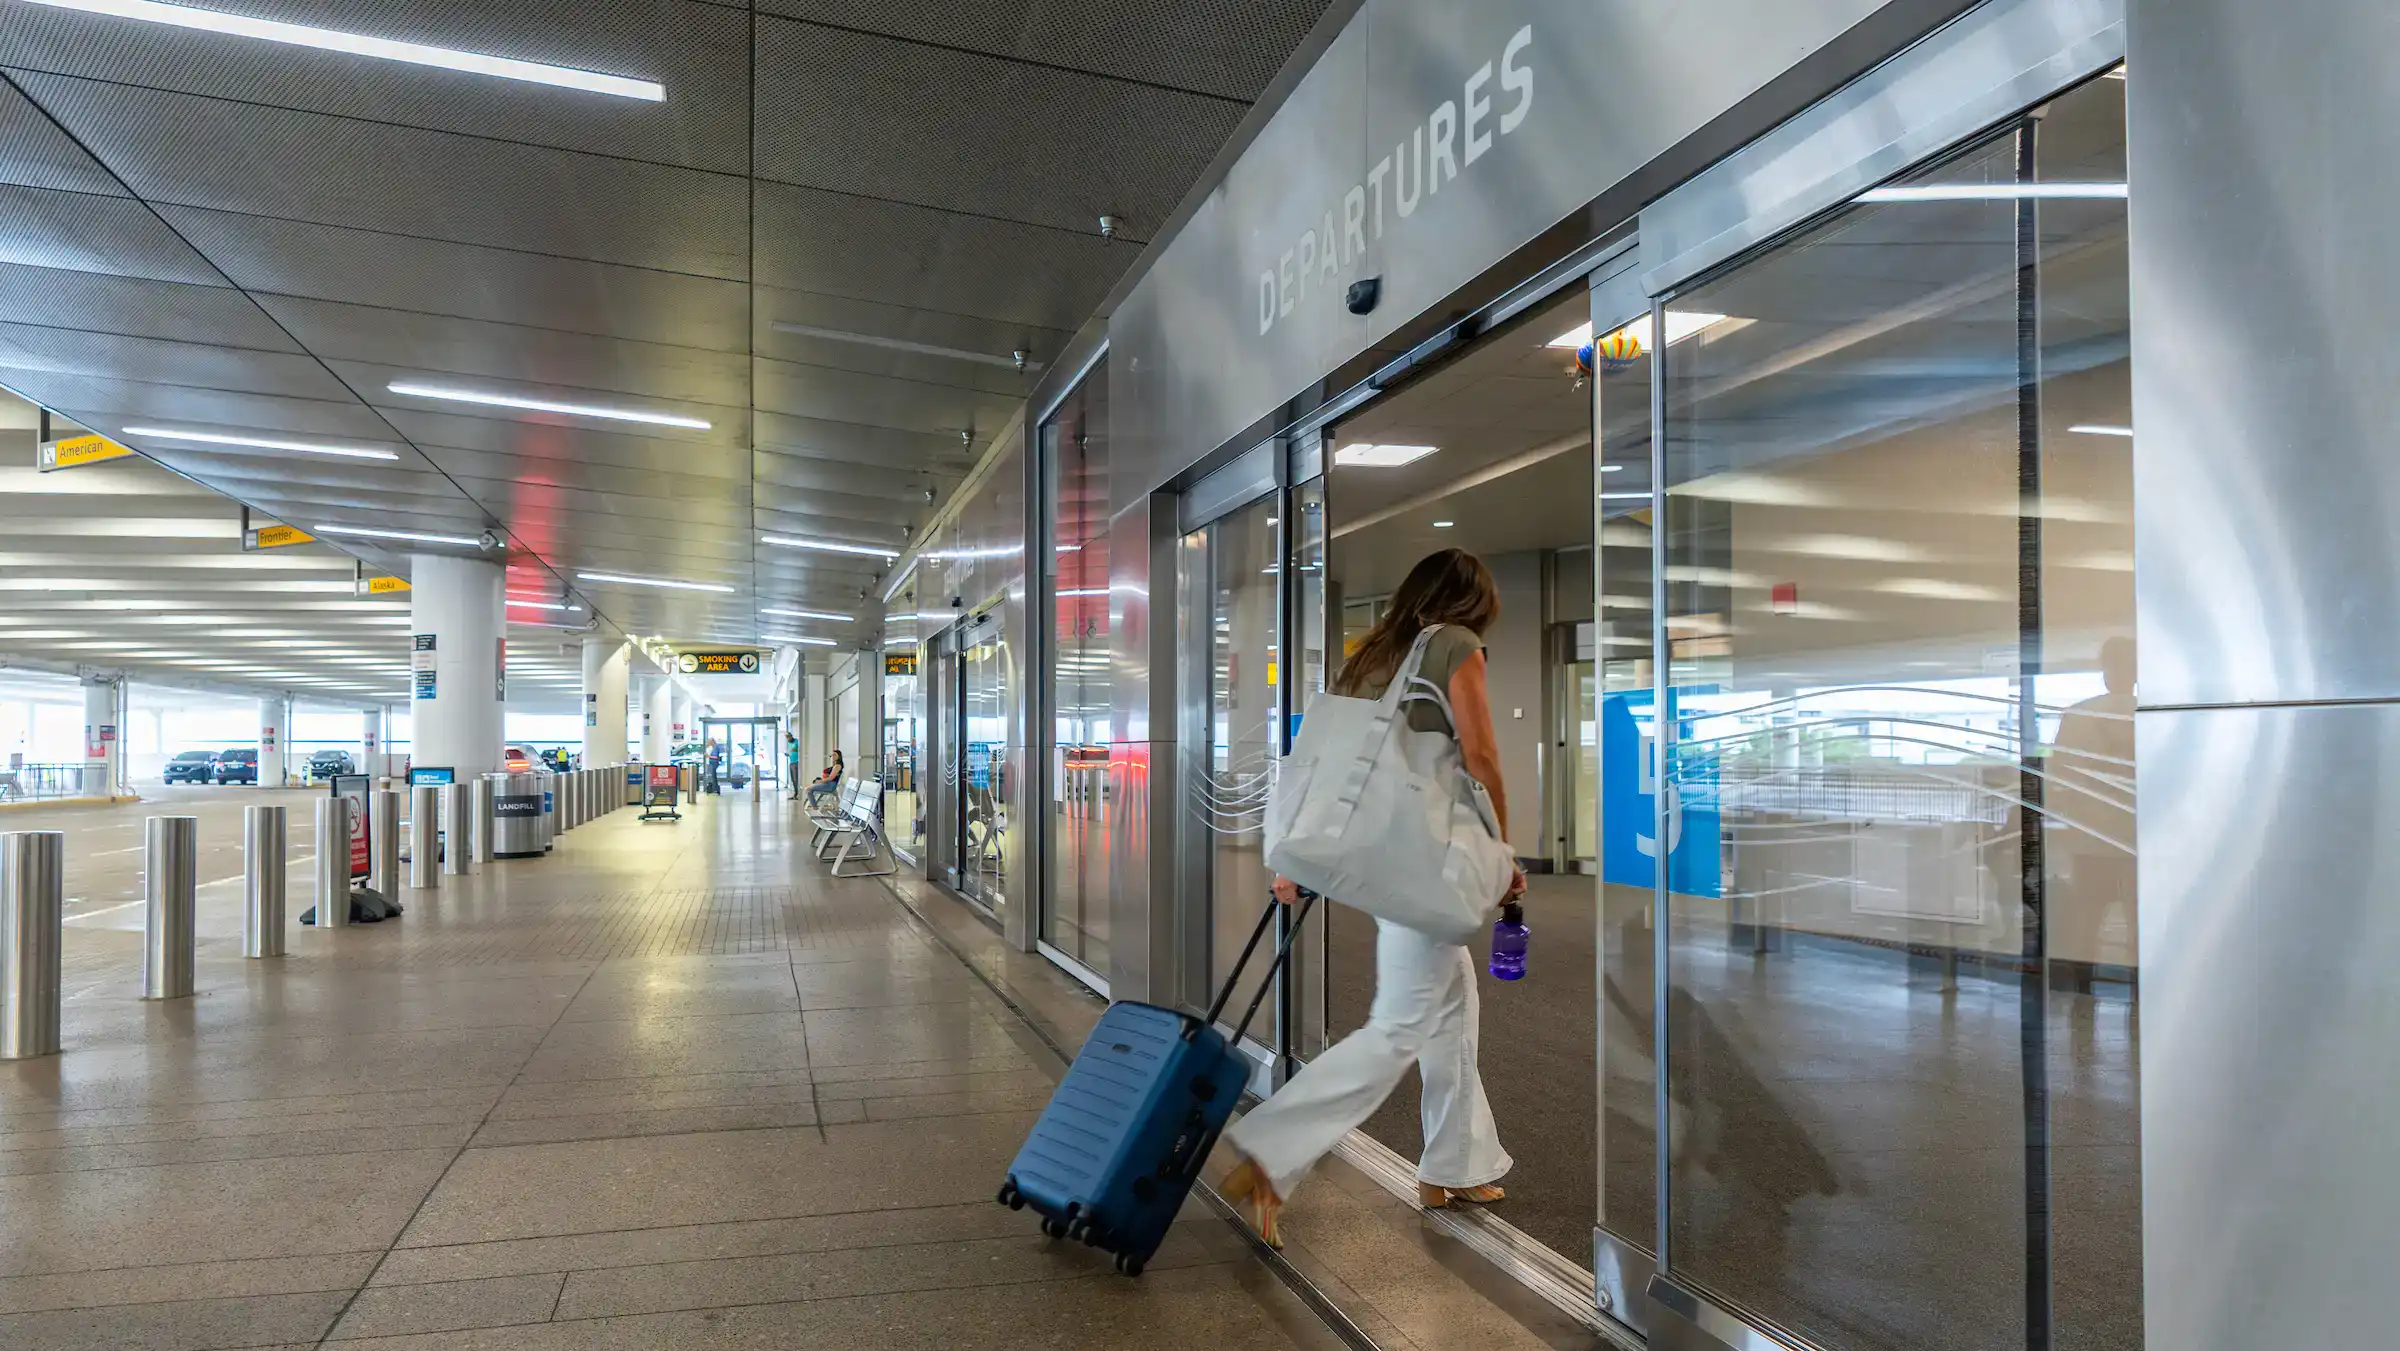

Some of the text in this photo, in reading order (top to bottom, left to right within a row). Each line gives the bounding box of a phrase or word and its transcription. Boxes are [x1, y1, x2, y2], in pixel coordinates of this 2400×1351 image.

[1259, 24, 1534, 337] DEPARTURES
[60, 441, 103, 458] American
[260, 528, 293, 544] Frontier
[374, 580, 395, 589] Alaska
[699, 655, 738, 663] SMOKING
[707, 663, 729, 671] AREA
